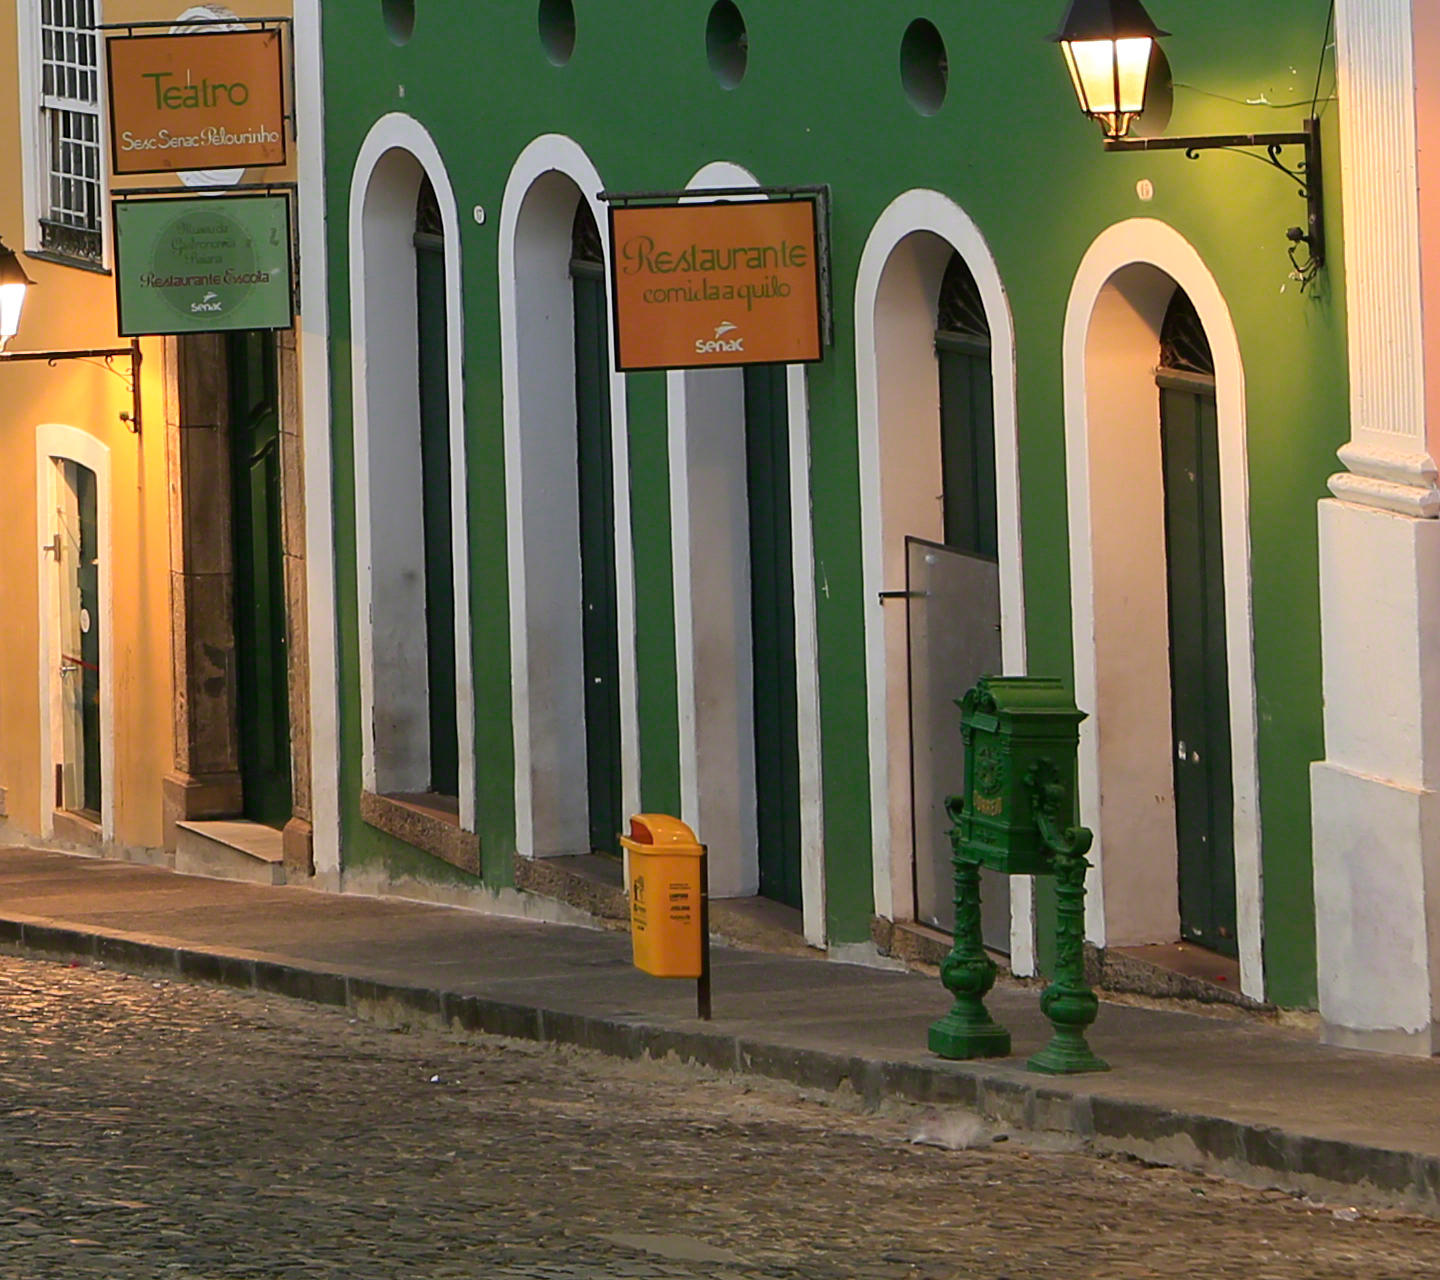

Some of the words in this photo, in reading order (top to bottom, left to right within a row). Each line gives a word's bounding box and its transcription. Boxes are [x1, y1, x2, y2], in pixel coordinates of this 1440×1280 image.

[141, 71, 250, 111] Teatro
[121, 131, 157, 151] Sesc
[158, 128, 199, 150] Senac
[200, 124, 280, 147] Pelourinho
[622, 235, 808, 276] Restaurante
[139, 272, 221, 289] Restaurante
[223, 267, 270, 286] Escola
[642, 277, 720, 304] comida
[722, 284, 735, 301] a
[737, 275, 792, 313] quilo
